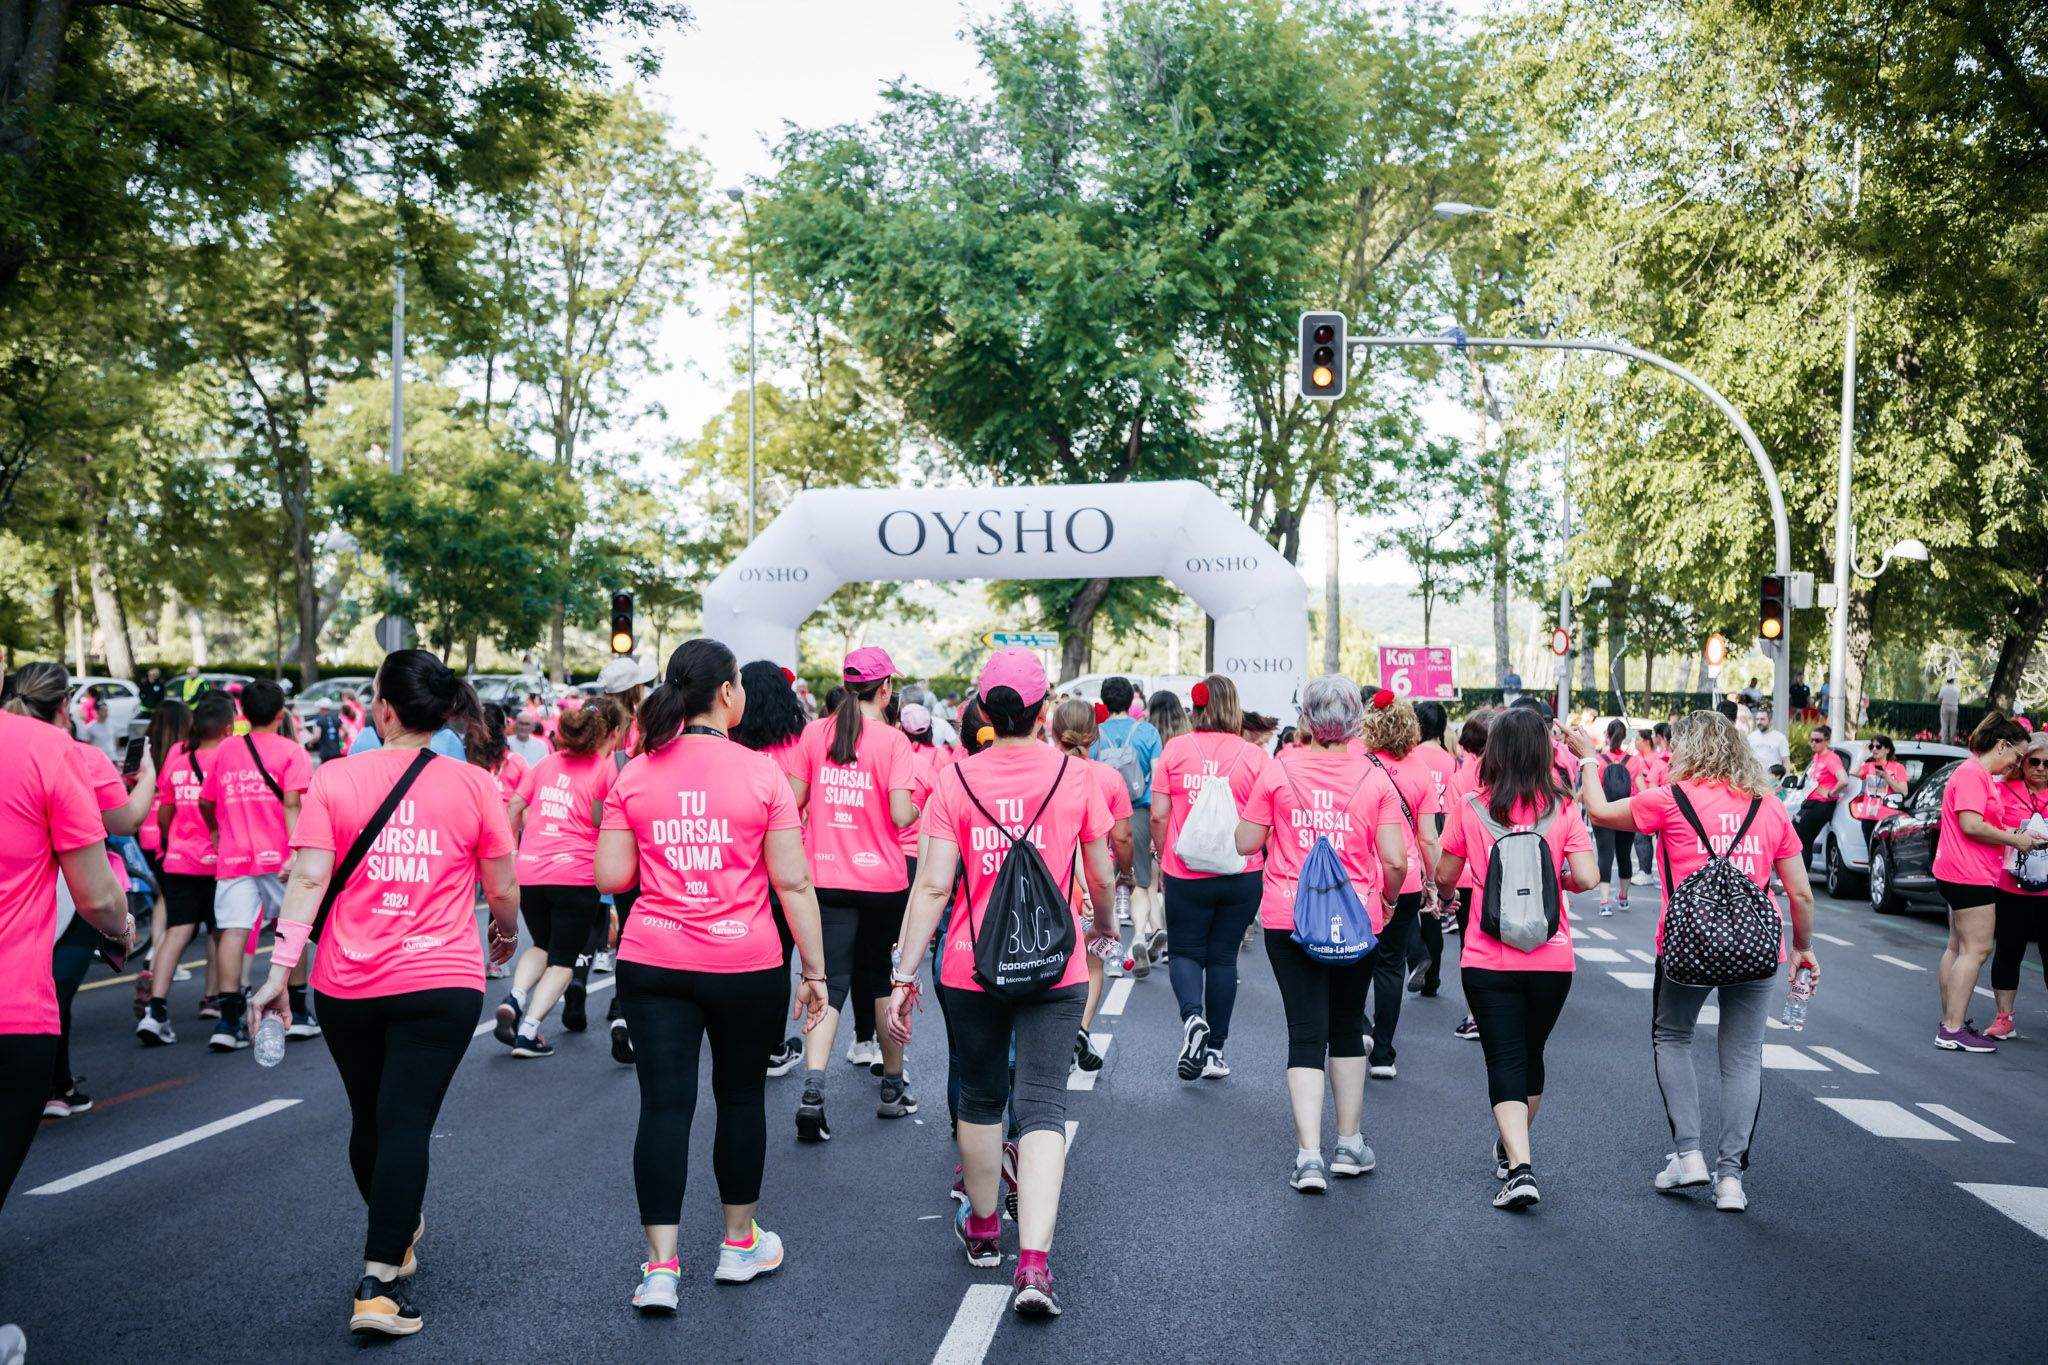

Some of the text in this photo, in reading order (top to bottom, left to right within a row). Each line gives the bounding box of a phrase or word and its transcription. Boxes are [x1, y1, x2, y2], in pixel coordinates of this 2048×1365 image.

[878, 507, 1114, 556] OYSHO
[739, 567, 808, 582] OYSHO
[1186, 556, 1258, 573] OYSHO
[1226, 657, 1293, 673] OYSHO
[1385, 649, 1415, 666] Km
[1391, 668, 1412, 698] 6
[820, 766, 873, 789] DORSAL
[678, 791, 706, 816] TU
[825, 786, 864, 808] SUMA
[1312, 790, 1333, 809] TU
[996, 799, 1024, 823] TU
[1291, 809, 1354, 831] DORSAL
[652, 819, 734, 845] DORSAL
[1718, 813, 1741, 833] TU
[359, 827, 443, 856] ORSAL
[367, 854, 429, 883] SUMA
[664, 846, 722, 871] SUMA
[685, 881, 709, 895] 2024
[383, 892, 409, 907] 2024
[643, 916, 683, 931] OYSHO
[1008, 905, 1051, 954] BUG
[1006, 976, 1032, 984] Microsoft
